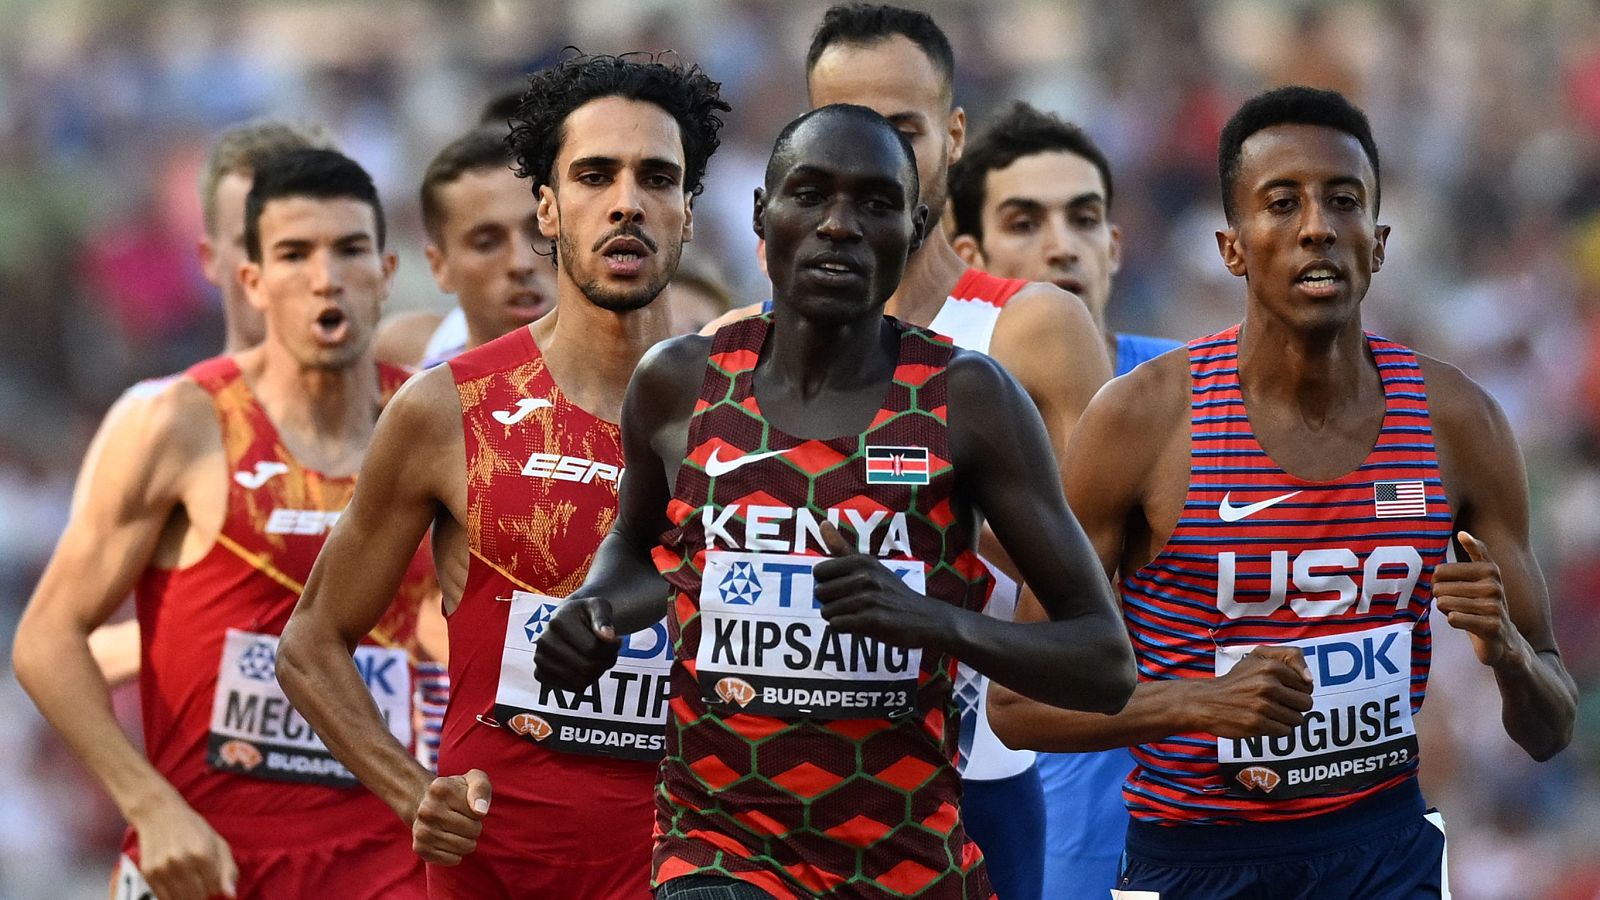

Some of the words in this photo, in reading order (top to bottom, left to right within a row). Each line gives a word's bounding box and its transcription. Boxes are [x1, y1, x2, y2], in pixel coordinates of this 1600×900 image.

[702, 504, 912, 557] KENYA
[1217, 545, 1424, 620] USA
[711, 618, 909, 673] KIPSANG
[1303, 631, 1400, 687] DK
[763, 686, 882, 708] BUDAPEST
[884, 690, 907, 706] 23
[1287, 753, 1388, 786] BUDAPEST
[1388, 748, 1409, 767] 23
